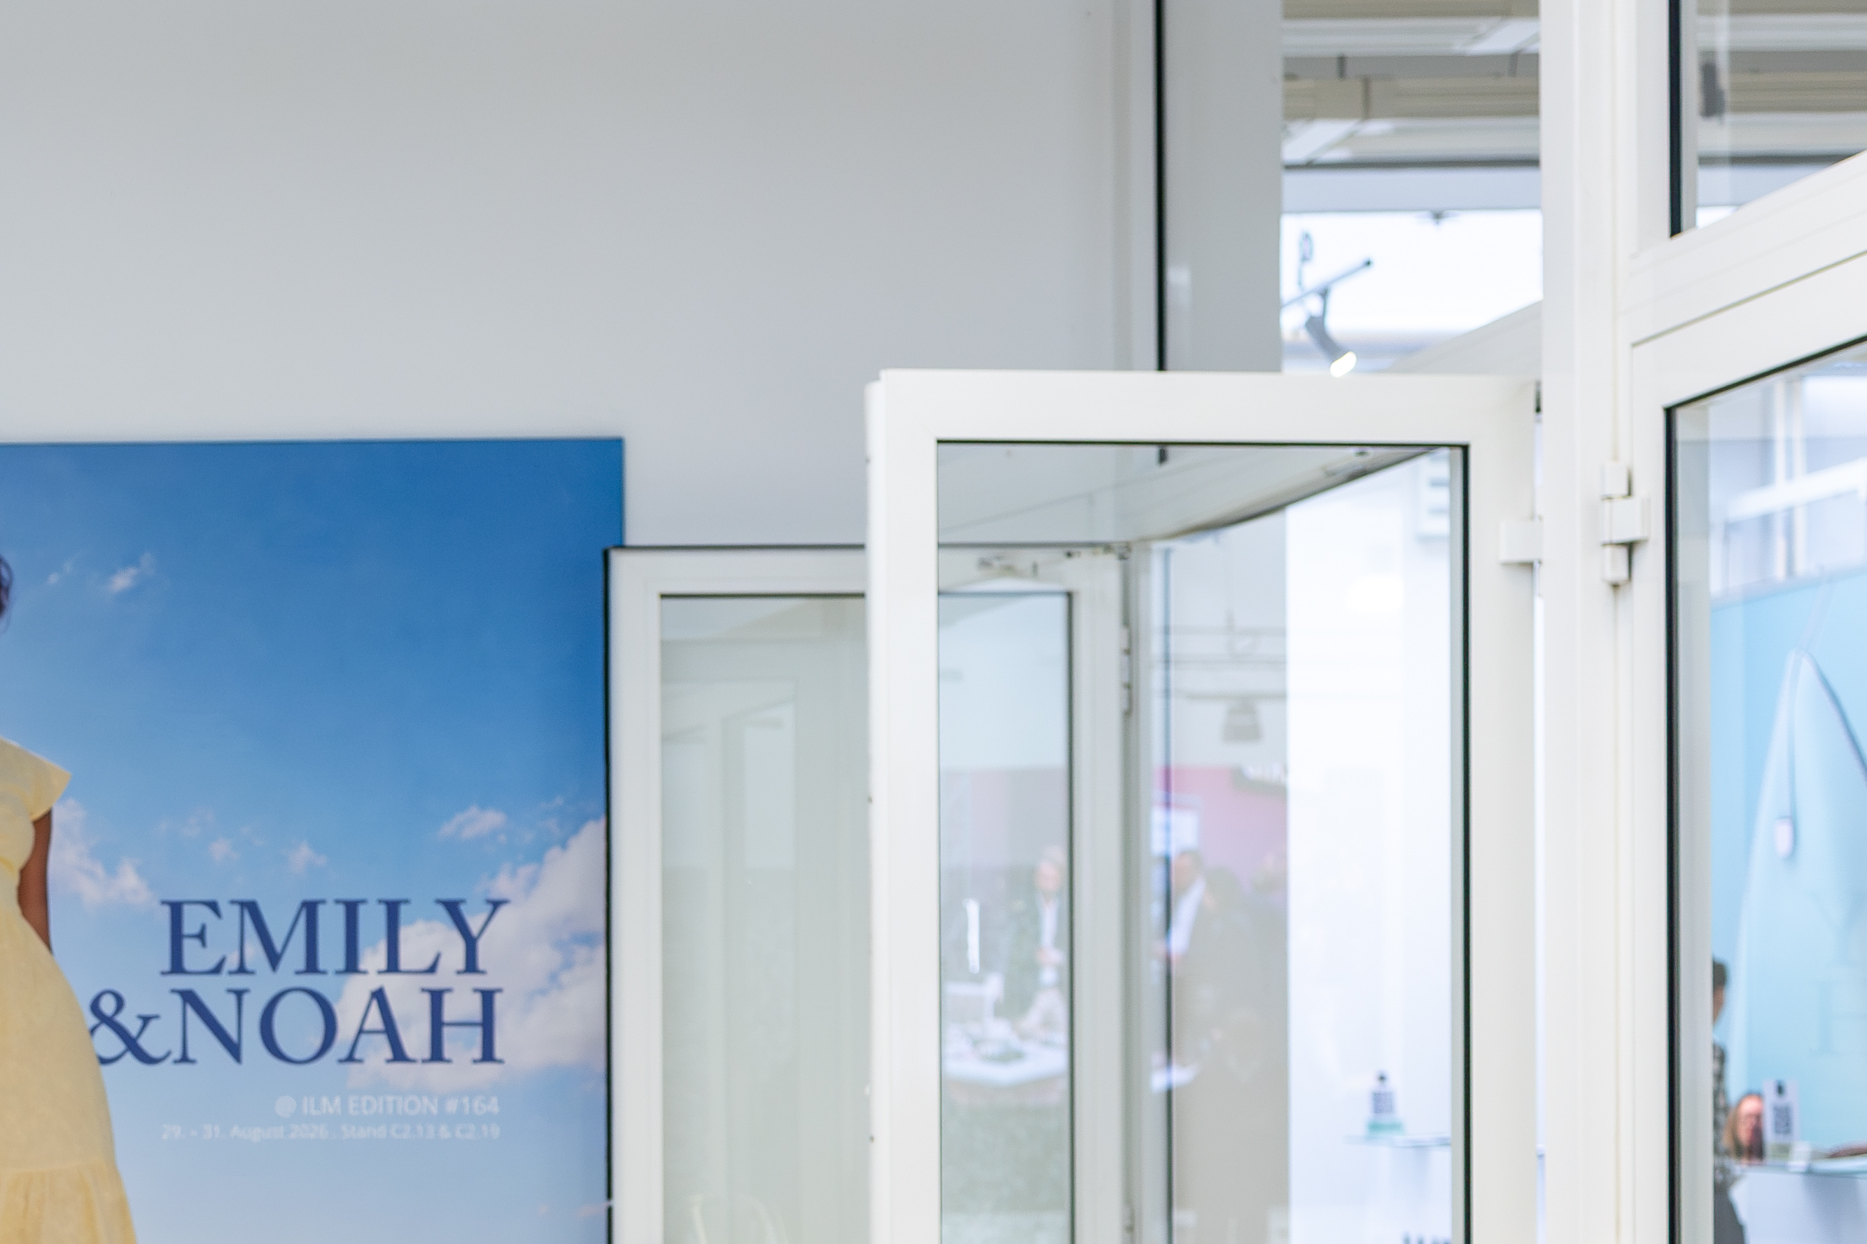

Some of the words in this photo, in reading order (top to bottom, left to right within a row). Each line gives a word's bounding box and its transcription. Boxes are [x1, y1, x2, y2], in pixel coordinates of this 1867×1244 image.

[160, 898, 510, 976] EMILY
[89, 986, 505, 1066] &NOAH
[301, 1095, 341, 1116] ILM
[347, 1095, 438, 1116] EDITION
[443, 1095, 500, 1116] #164
[229, 1123, 285, 1143] August
